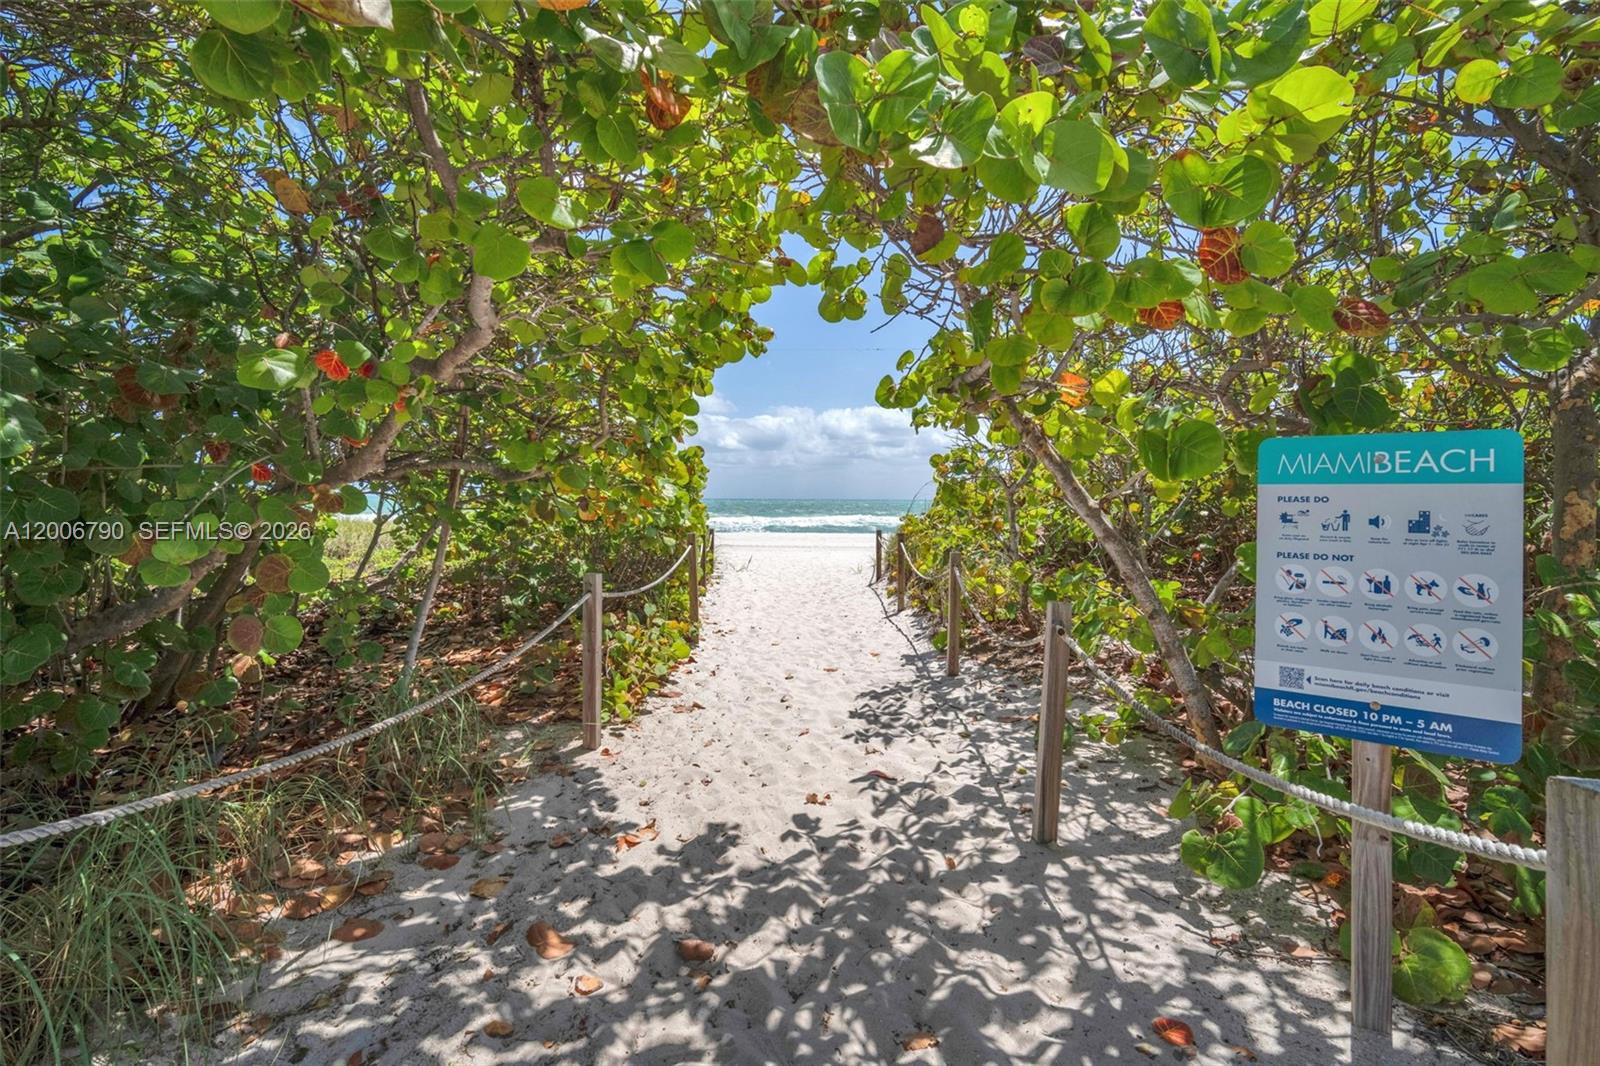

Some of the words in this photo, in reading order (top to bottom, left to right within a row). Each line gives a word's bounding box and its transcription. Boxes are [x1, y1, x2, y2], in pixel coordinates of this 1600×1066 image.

[1277, 495, 1310, 504] PLEASE
[1314, 495, 1330, 504] DO
[1276, 551, 1310, 560] PLEASE
[1313, 552, 1329, 561] DO
[1332, 554, 1355, 562] NOT
[1273, 698, 1310, 711] BEACH
[1313, 704, 1358, 718] CLOSED
[1363, 711, 1379, 721] 10
[1382, 714, 1403, 725] PM
[1417, 719, 1425, 729] 5
[1429, 721, 1453, 733] AM
